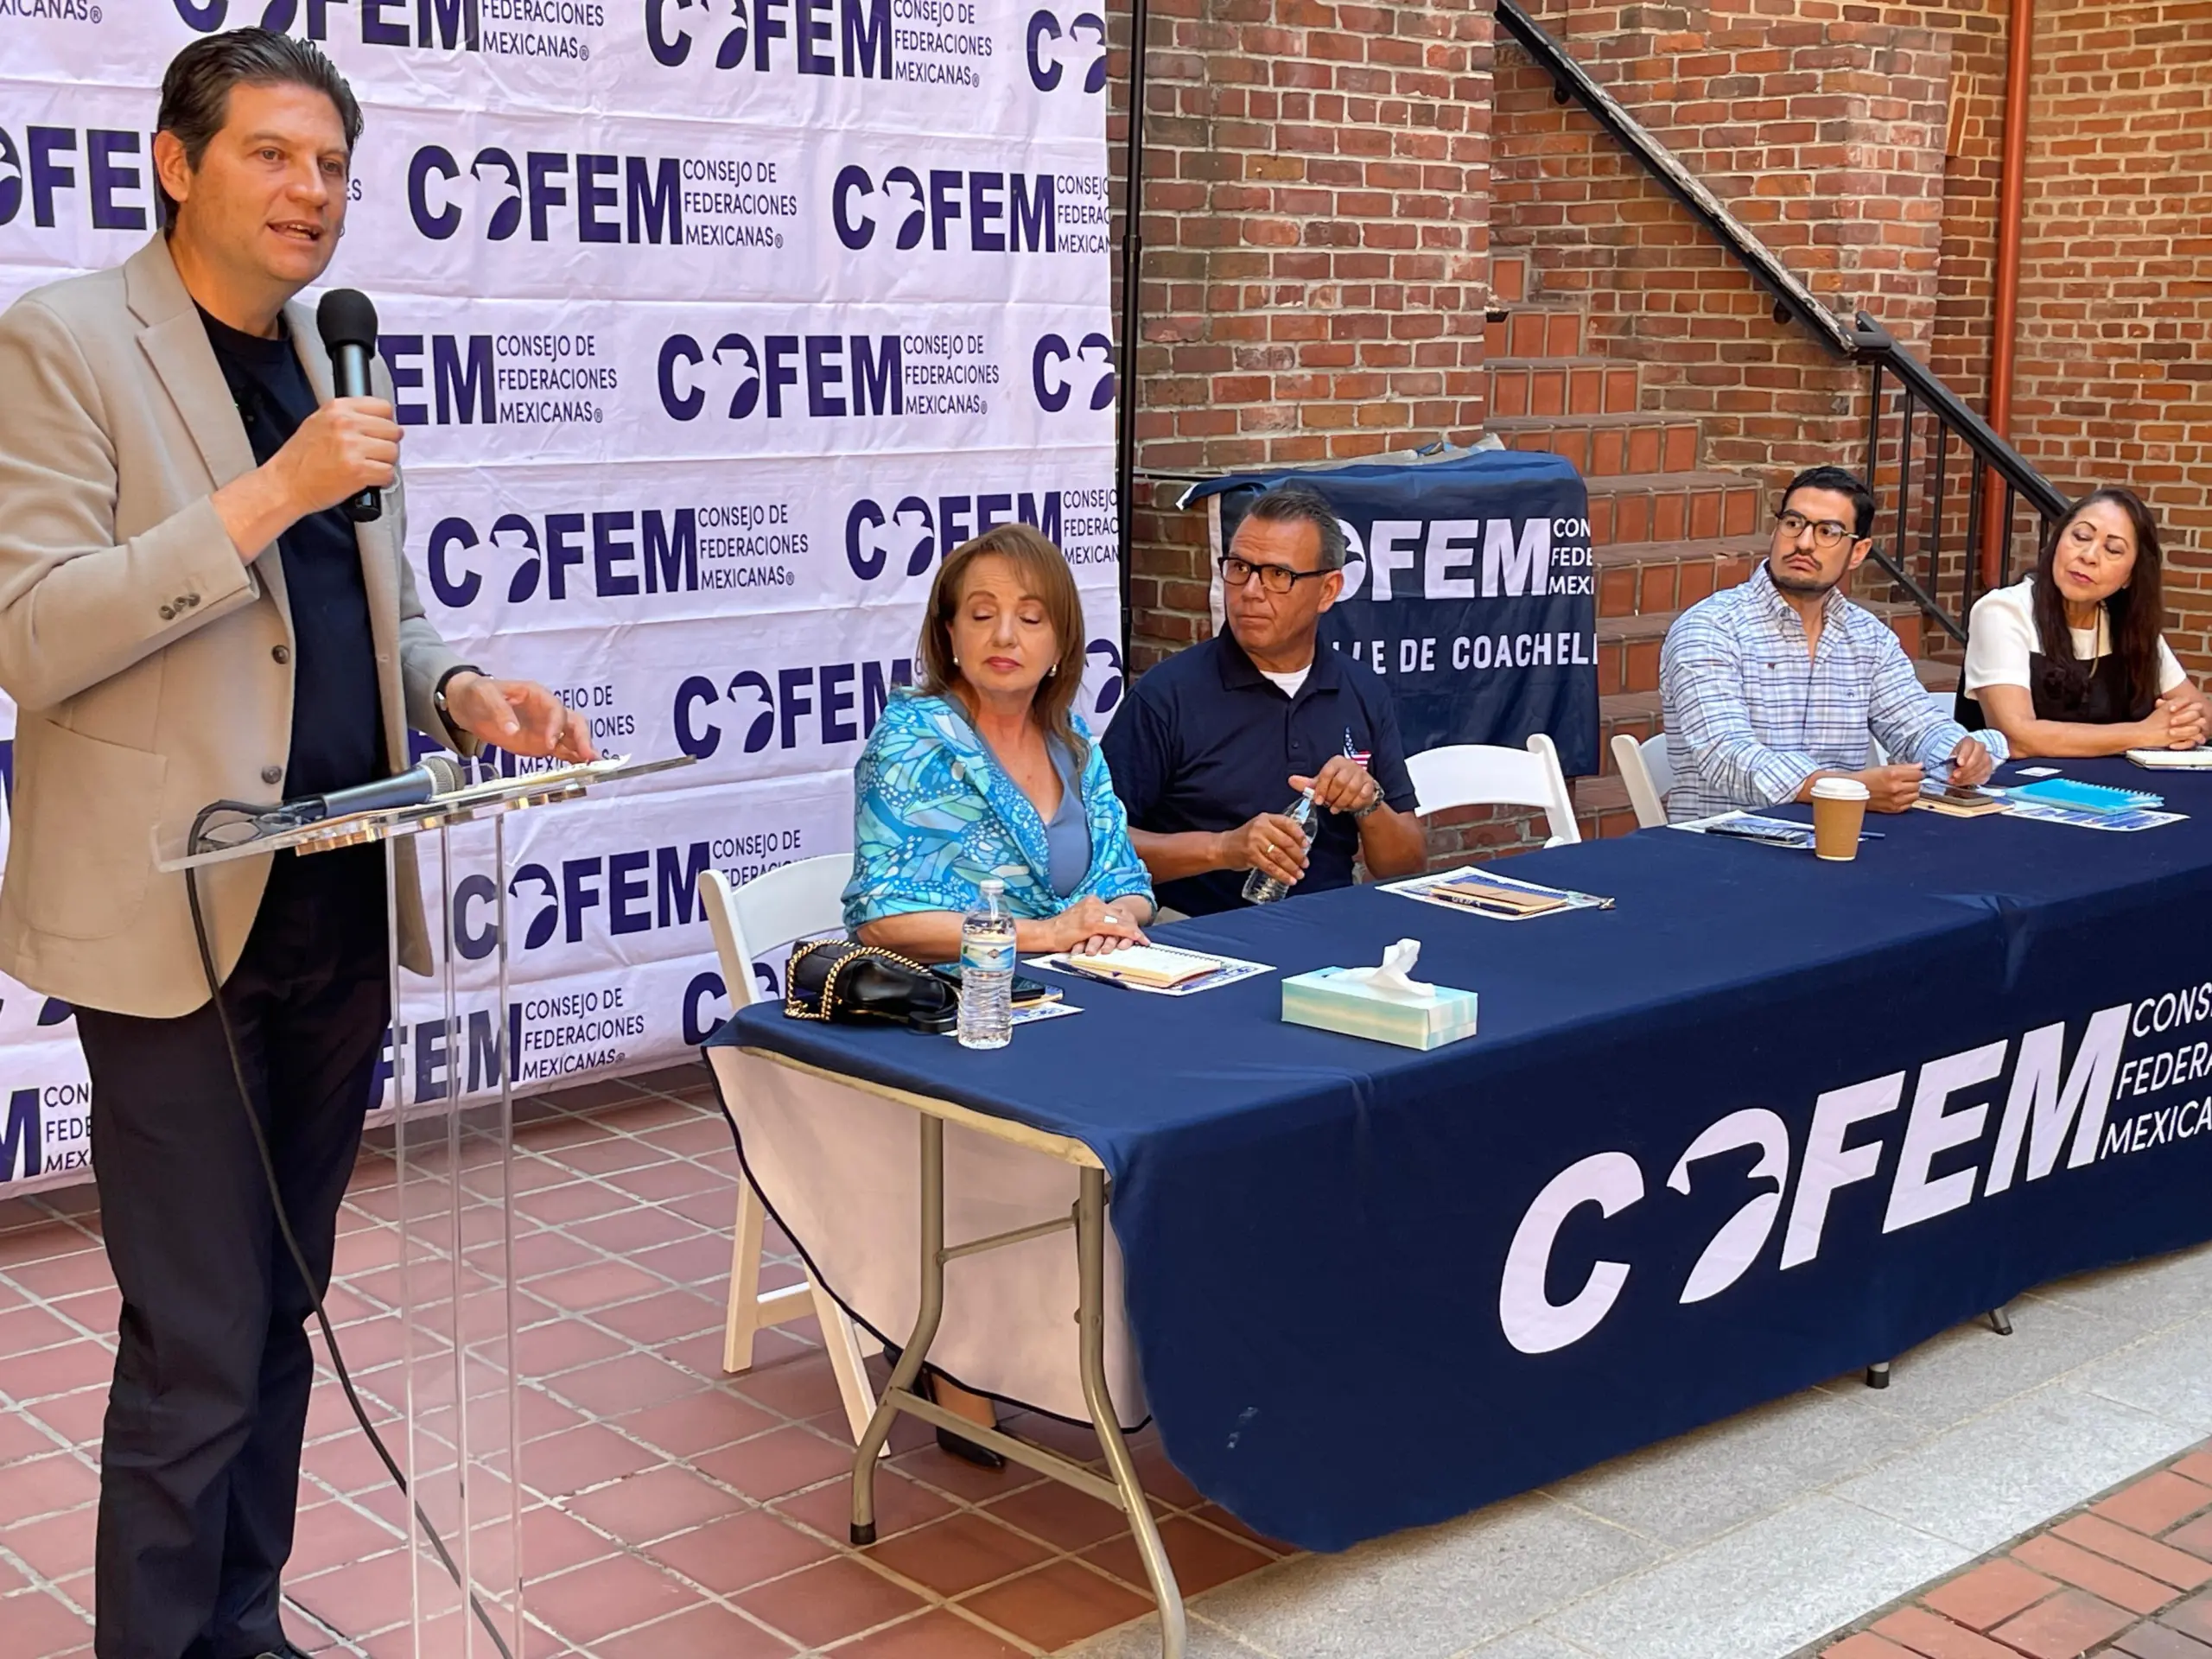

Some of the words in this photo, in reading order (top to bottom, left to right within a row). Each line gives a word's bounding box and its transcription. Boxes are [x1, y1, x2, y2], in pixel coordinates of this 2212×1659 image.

[482, 0, 605, 27] FEDERACIONES
[893, 0, 954, 28] CONSEJO
[957, 3, 975, 24] DE
[894, 29, 993, 56] FEDERACIONES
[683, 159, 753, 188] CONSEJO
[757, 162, 777, 183] DE
[684, 192, 798, 216] FEDERACIONES
[496, 334, 570, 363] CONSEJO
[575, 335, 595, 356] DE
[903, 334, 963, 359] CONSEJO
[968, 335, 984, 354] DE
[498, 368, 618, 391] FEDERACIONES
[905, 365, 1000, 385] FEDERACIONES
[697, 505, 765, 531] CONSEJO
[769, 504, 788, 524] DE
[700, 533, 809, 560] FEDERACIONES
[1400, 638, 1436, 673] DE
[594, 685, 613, 707] DE
[712, 833, 779, 859] CONSEJO
[782, 830, 801, 849] DE
[524, 992, 598, 1020] CONSEJO
[603, 988, 624, 1009] DE
[524, 1015, 645, 1052] FEDERACIONES
